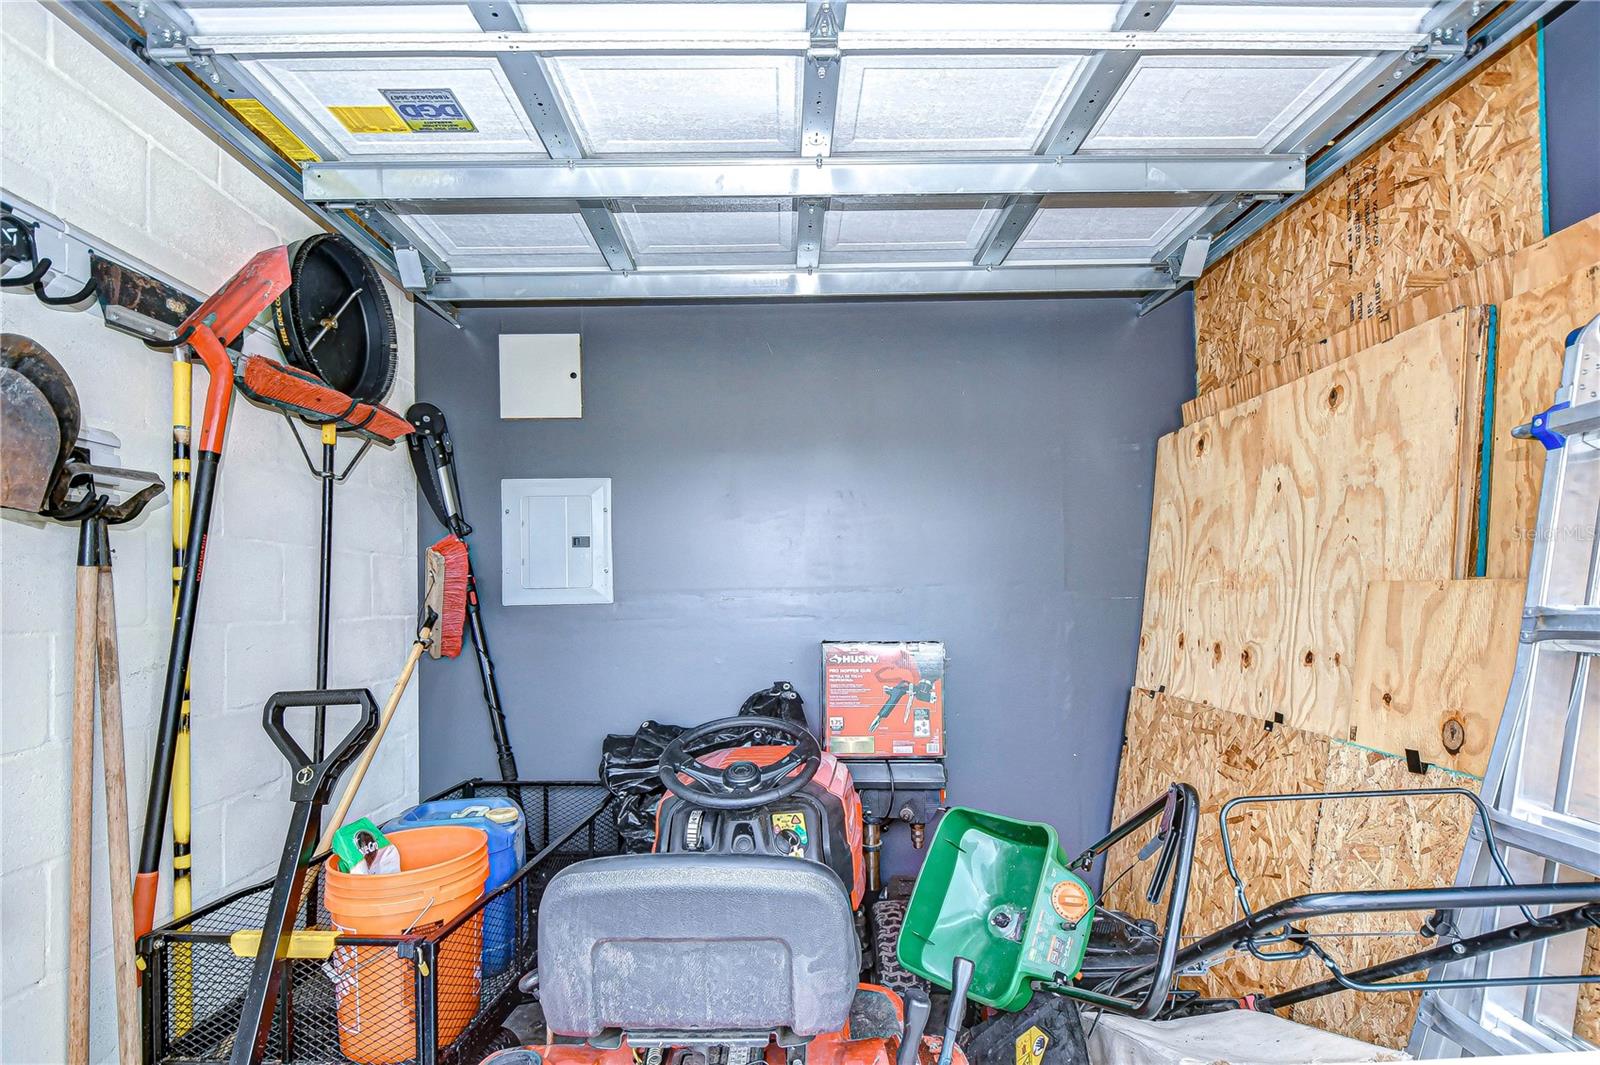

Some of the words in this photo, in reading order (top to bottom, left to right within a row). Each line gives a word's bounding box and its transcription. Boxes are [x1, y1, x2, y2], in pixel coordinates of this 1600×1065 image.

[399, 104, 463, 117] DGD
[280, 327, 289, 345] STEEL
[842, 655, 878, 663] HUSKY
